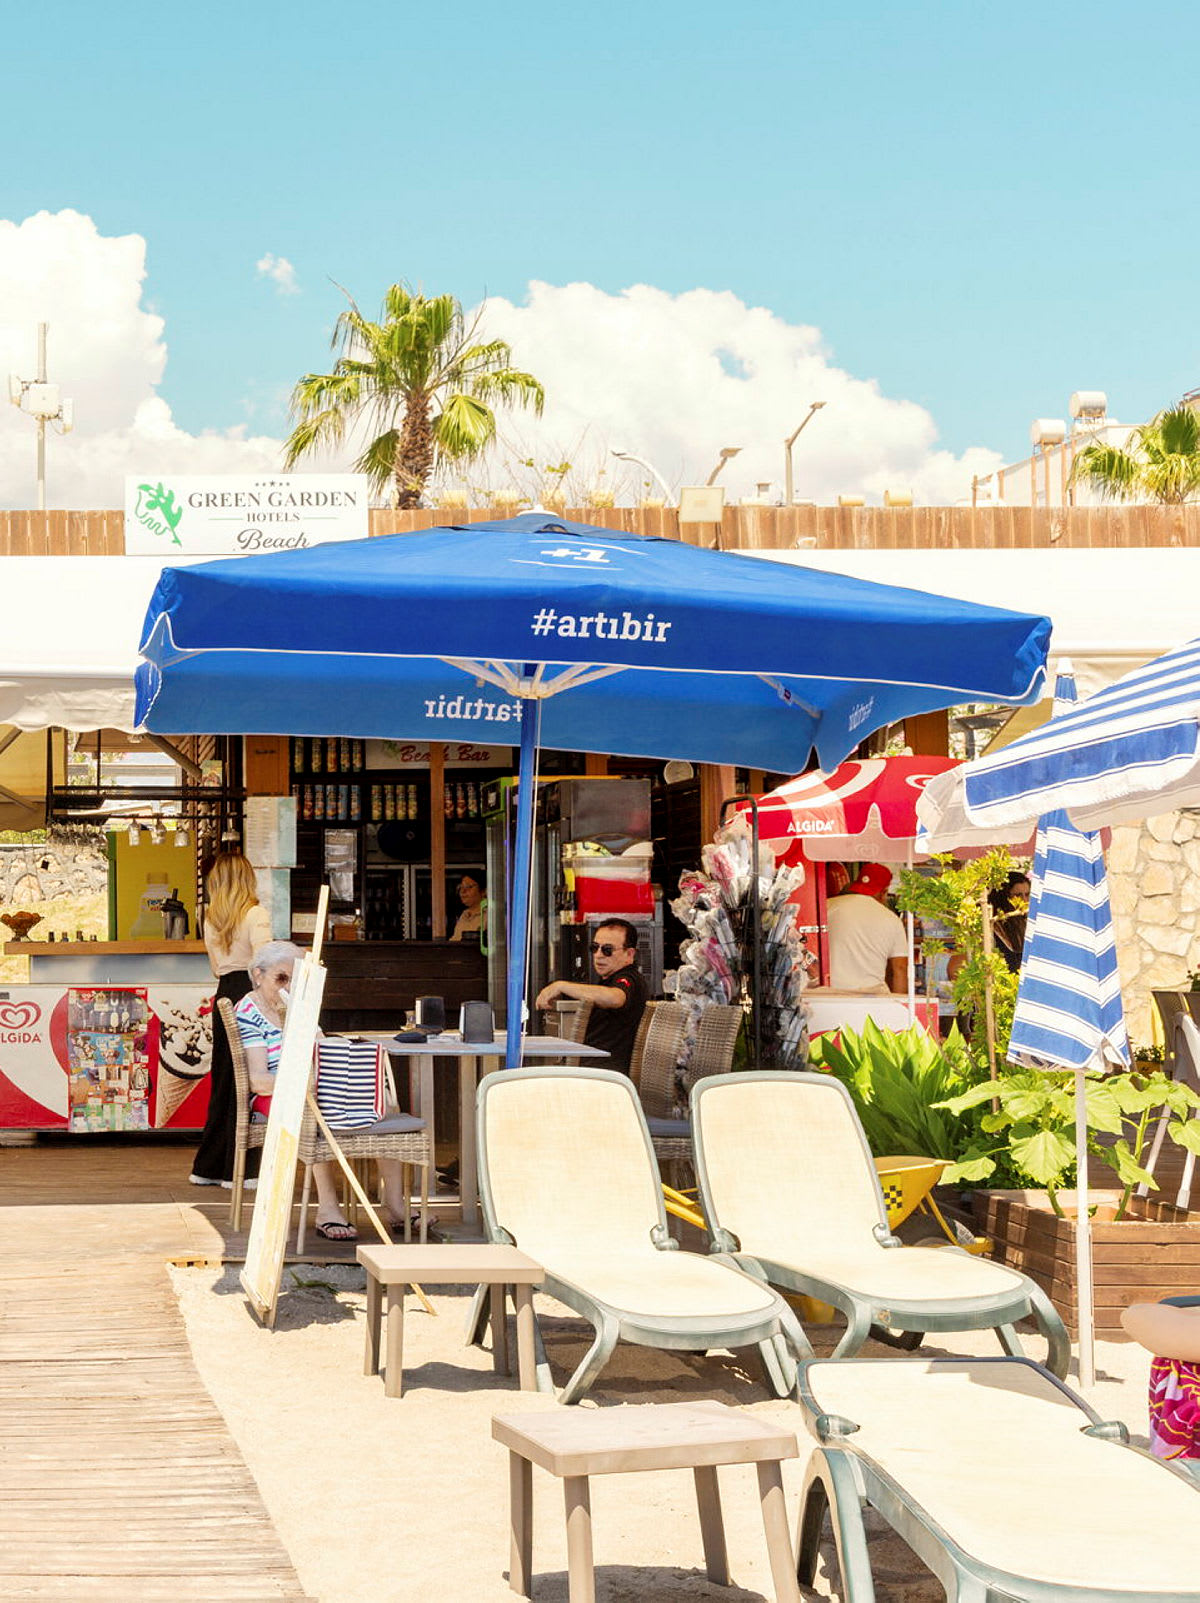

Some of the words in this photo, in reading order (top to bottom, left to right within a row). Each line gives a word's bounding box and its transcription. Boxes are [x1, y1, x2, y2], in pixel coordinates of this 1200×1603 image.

[188, 491, 262, 508] GREEN
[268, 491, 357, 508] GARDEN
[246, 511, 301, 523] HOTELS
[236, 528, 310, 550] Beach
[540, 548, 612, 563] +1
[457, 743, 490, 761] Bar
